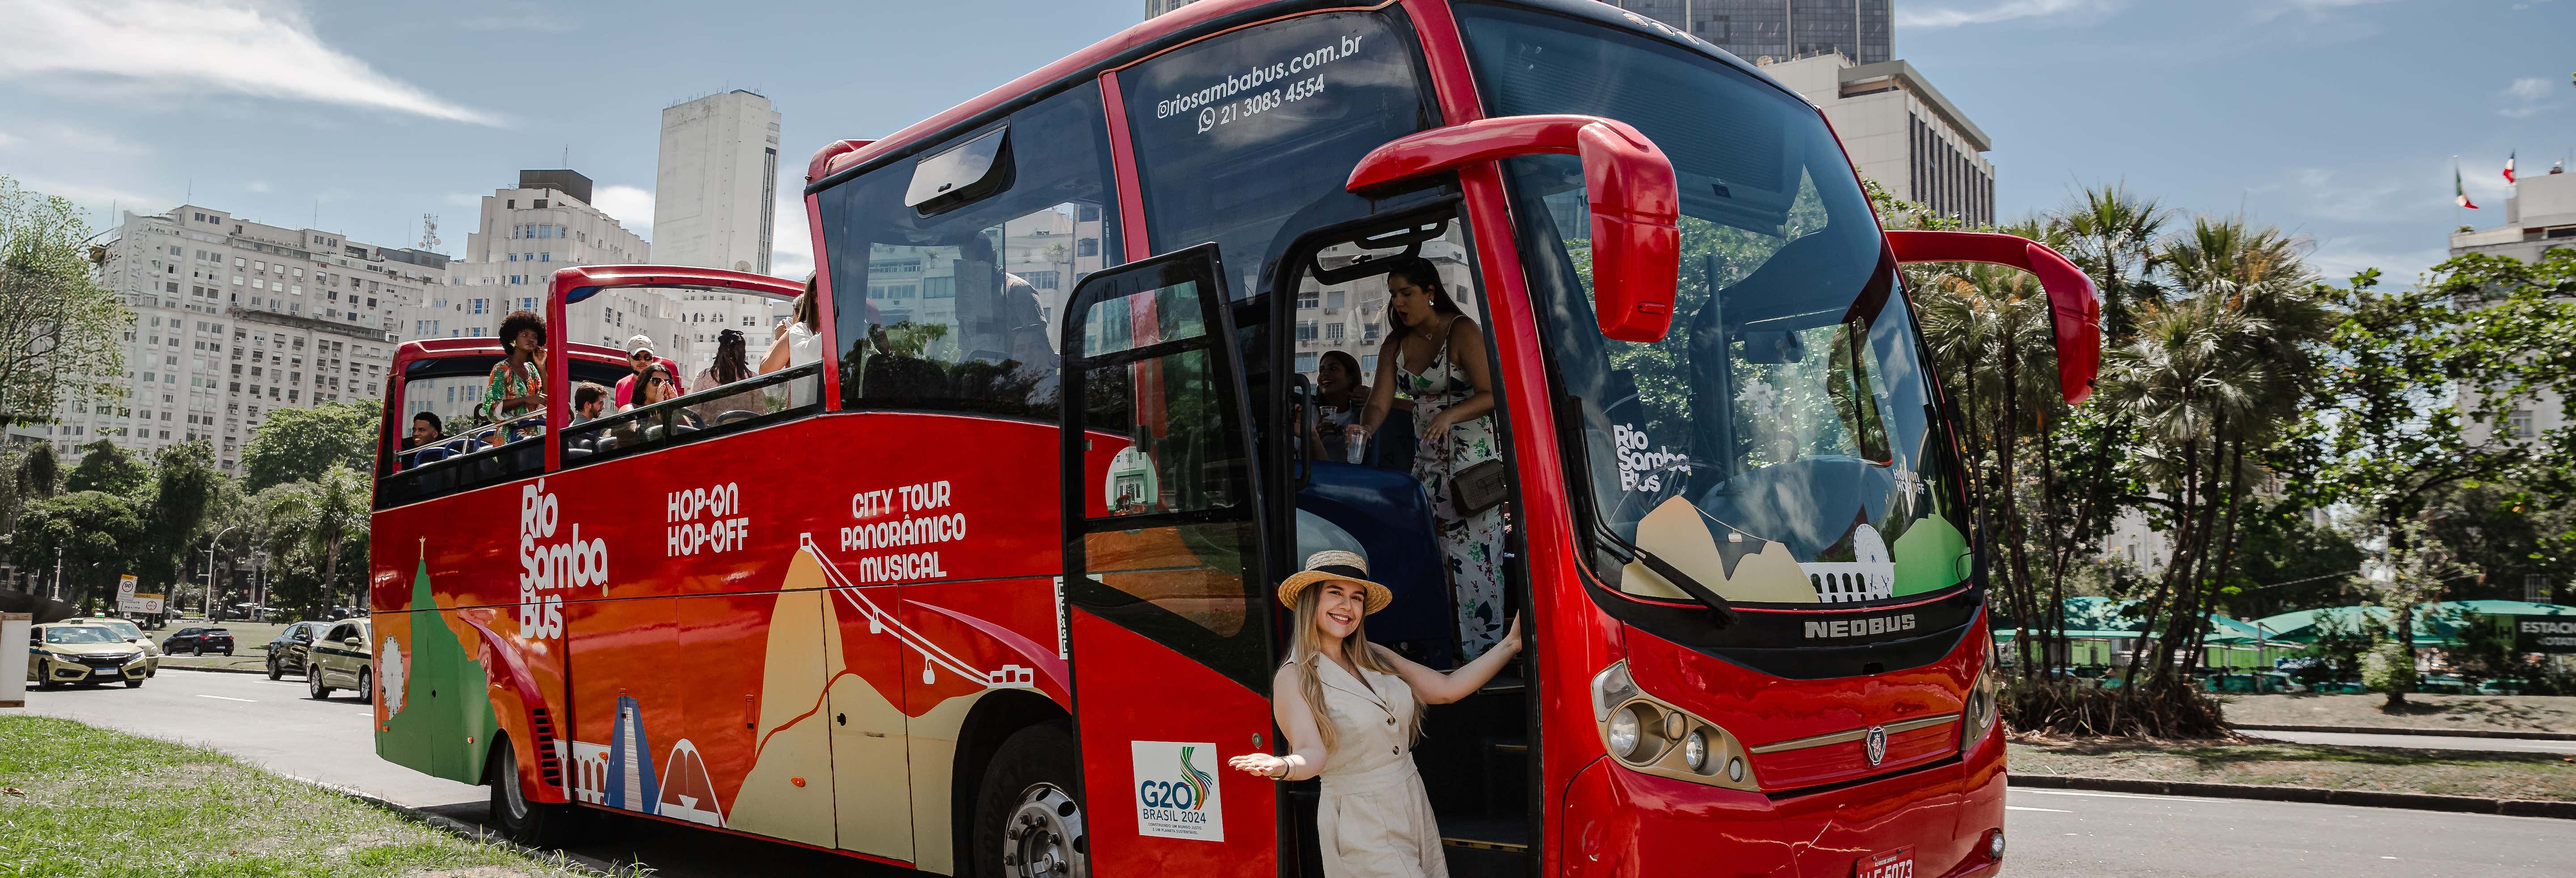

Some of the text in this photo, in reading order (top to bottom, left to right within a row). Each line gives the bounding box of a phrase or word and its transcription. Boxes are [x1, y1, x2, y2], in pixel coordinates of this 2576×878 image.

[1220, 73, 1325, 125] 21 3083 4554
[1614, 423, 1648, 450] Rio
[1617, 446, 1692, 472] Samba
[852, 480, 951, 519] CITY TOUR
[1619, 469, 1661, 492] Bus
[521, 477, 558, 540] Rio
[668, 482, 738, 523] HOP-ON
[668, 517, 749, 557] HOP-OFF
[841, 513, 966, 552] PANORÂMICO
[520, 523, 608, 591] Samba
[860, 551, 947, 583] MUSICAL
[520, 585, 563, 640] Bus
[1805, 614, 1915, 638] NEOBUS
[1140, 780, 1192, 810] G20
[1143, 808, 1207, 824] BRASIL 2024
